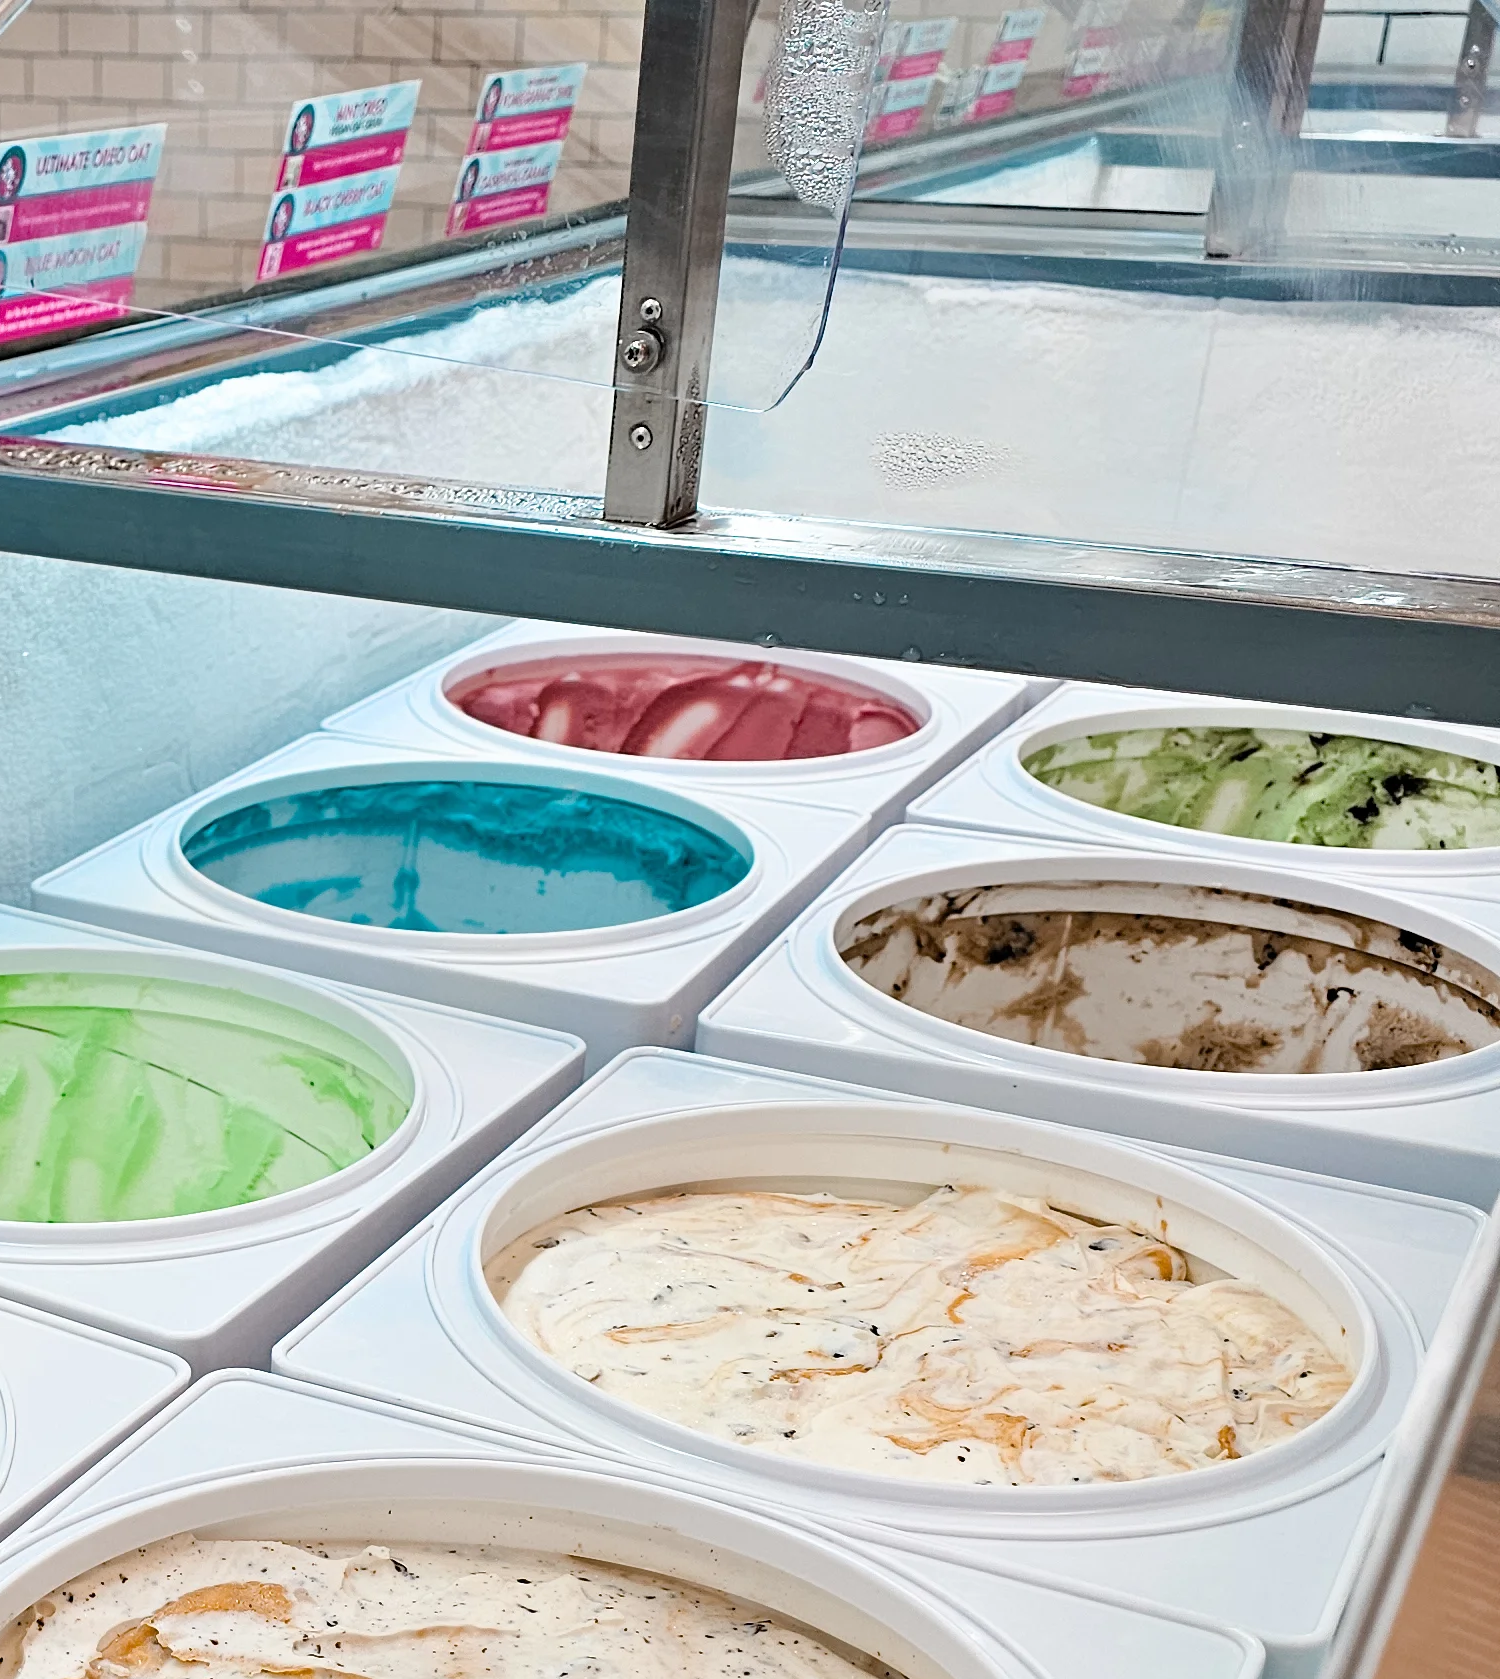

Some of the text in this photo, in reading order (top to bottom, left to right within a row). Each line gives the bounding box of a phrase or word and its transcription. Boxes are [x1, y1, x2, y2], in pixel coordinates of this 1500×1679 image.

[35, 144, 151, 175] ULTIMATE OREO OAT
